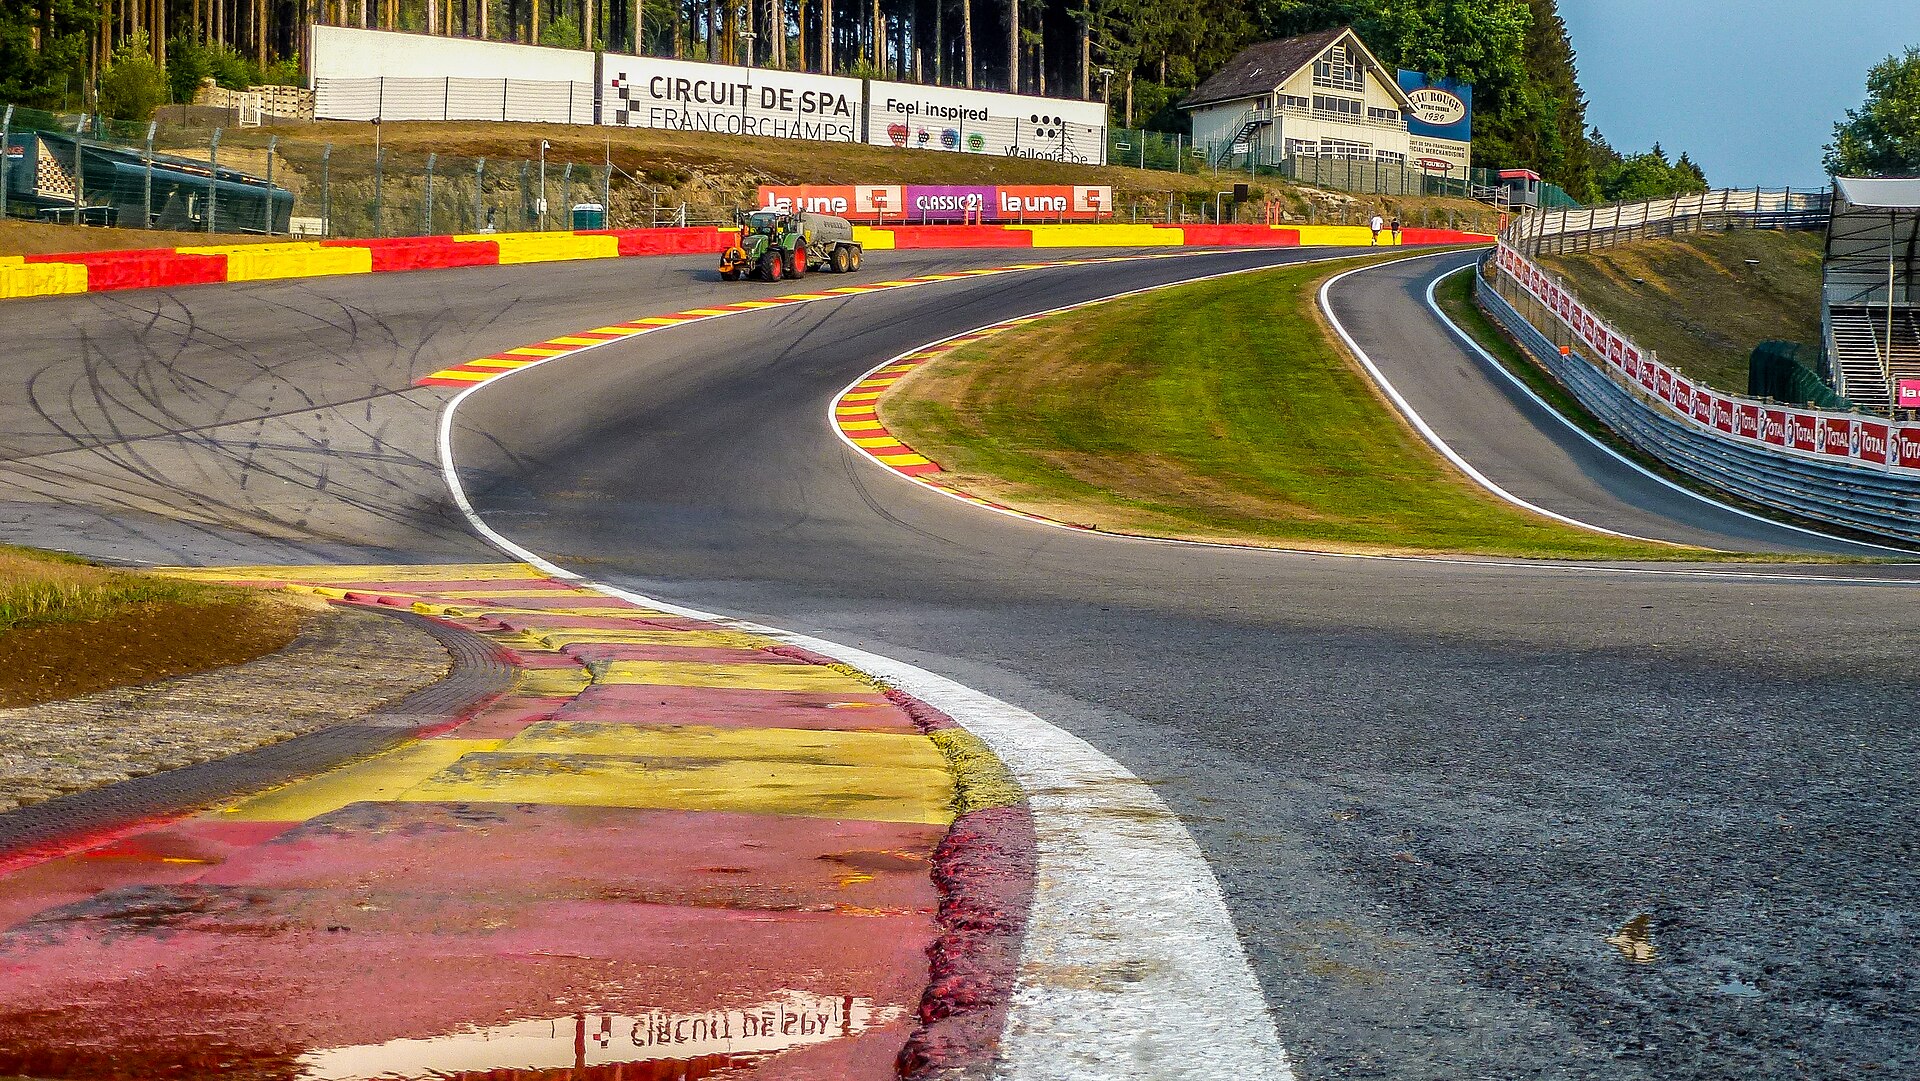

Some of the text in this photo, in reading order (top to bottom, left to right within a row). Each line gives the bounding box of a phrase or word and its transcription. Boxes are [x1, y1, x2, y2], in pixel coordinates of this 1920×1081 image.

[650, 76, 850, 117] CIRCUIT DE SPA
[1430, 92, 1461, 112] ROUGE
[886, 99, 988, 121] Feel inspired
[1424, 112, 1445, 122] 1939
[650, 107, 851, 141] FRANCORCHAMPS
[796, 196, 848, 213] une
[1001, 191, 1067, 212] la une
[1902, 387, 1917, 397] la
[1741, 412, 1758, 431] TOTAL
[1766, 418, 1785, 438] TOTAL
[1795, 423, 1816, 443] TOTAL
[1827, 427, 1849, 447] TOTAL
[1862, 431, 1886, 455] TOTAL
[1901, 437, 1920, 459] TOTA
